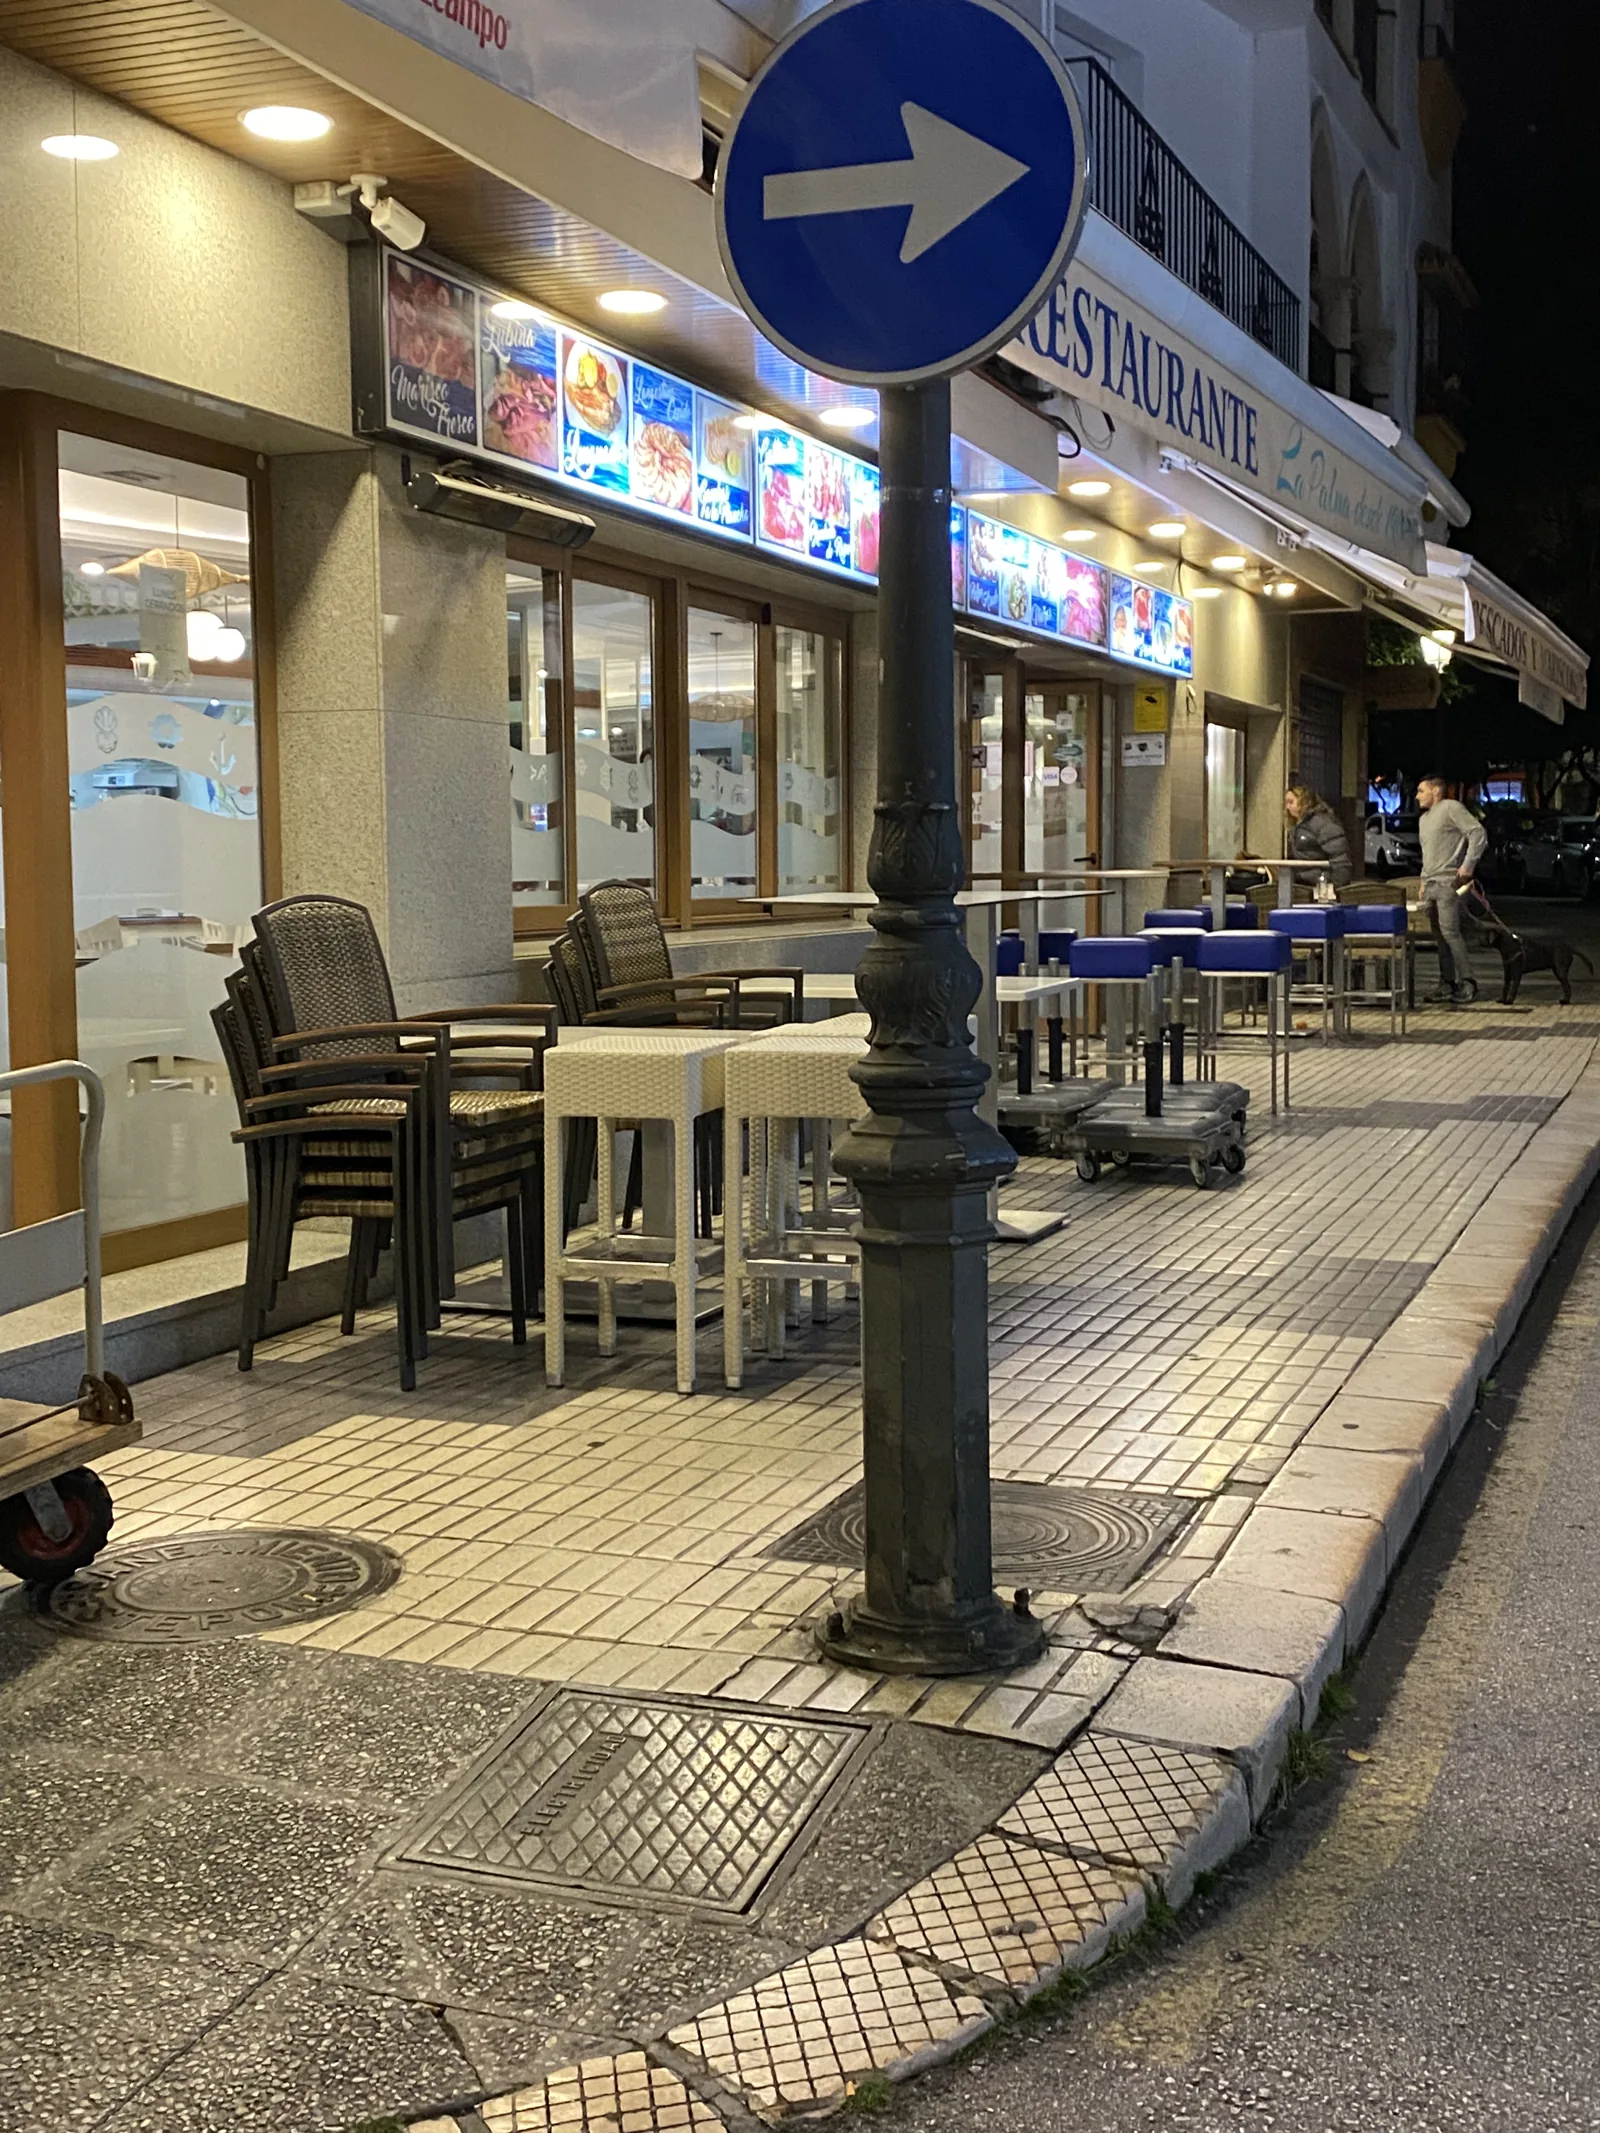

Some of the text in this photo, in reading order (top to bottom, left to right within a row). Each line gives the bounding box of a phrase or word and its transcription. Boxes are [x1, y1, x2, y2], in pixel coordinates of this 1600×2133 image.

[421, 0, 507, 50] ampo
[391, 364, 448, 411] Marisco
[427, 399, 475, 438] Fresco
[1276, 421, 1304, 500] La
[1309, 450, 1350, 519] Palma
[1472, 599, 1527, 667] PESCADOS
[520, 1733, 627, 1837] ELECTRICIDAD
